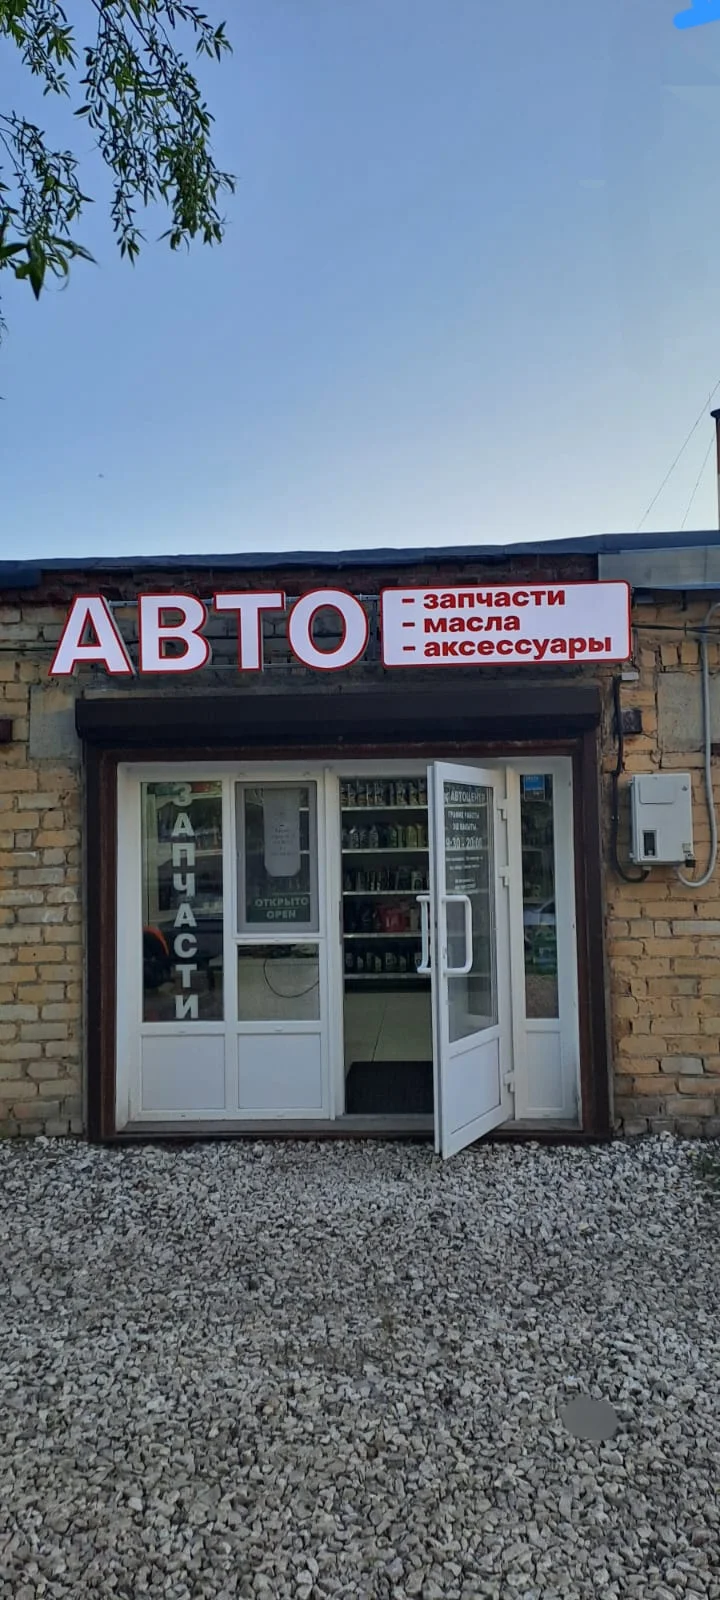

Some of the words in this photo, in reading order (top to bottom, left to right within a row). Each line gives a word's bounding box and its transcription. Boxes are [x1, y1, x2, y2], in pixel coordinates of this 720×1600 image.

[423, 589, 565, 610] запчасти
[49, 587, 369, 676] АВТО
[424, 615, 521, 633] масла
[424, 636, 612, 660] аксессуары
[171, 783, 199, 1019] ЗАПЧАСТИ
[254, 896, 309, 907] ОТКРЫТО
[266, 909, 296, 920] OPEN
